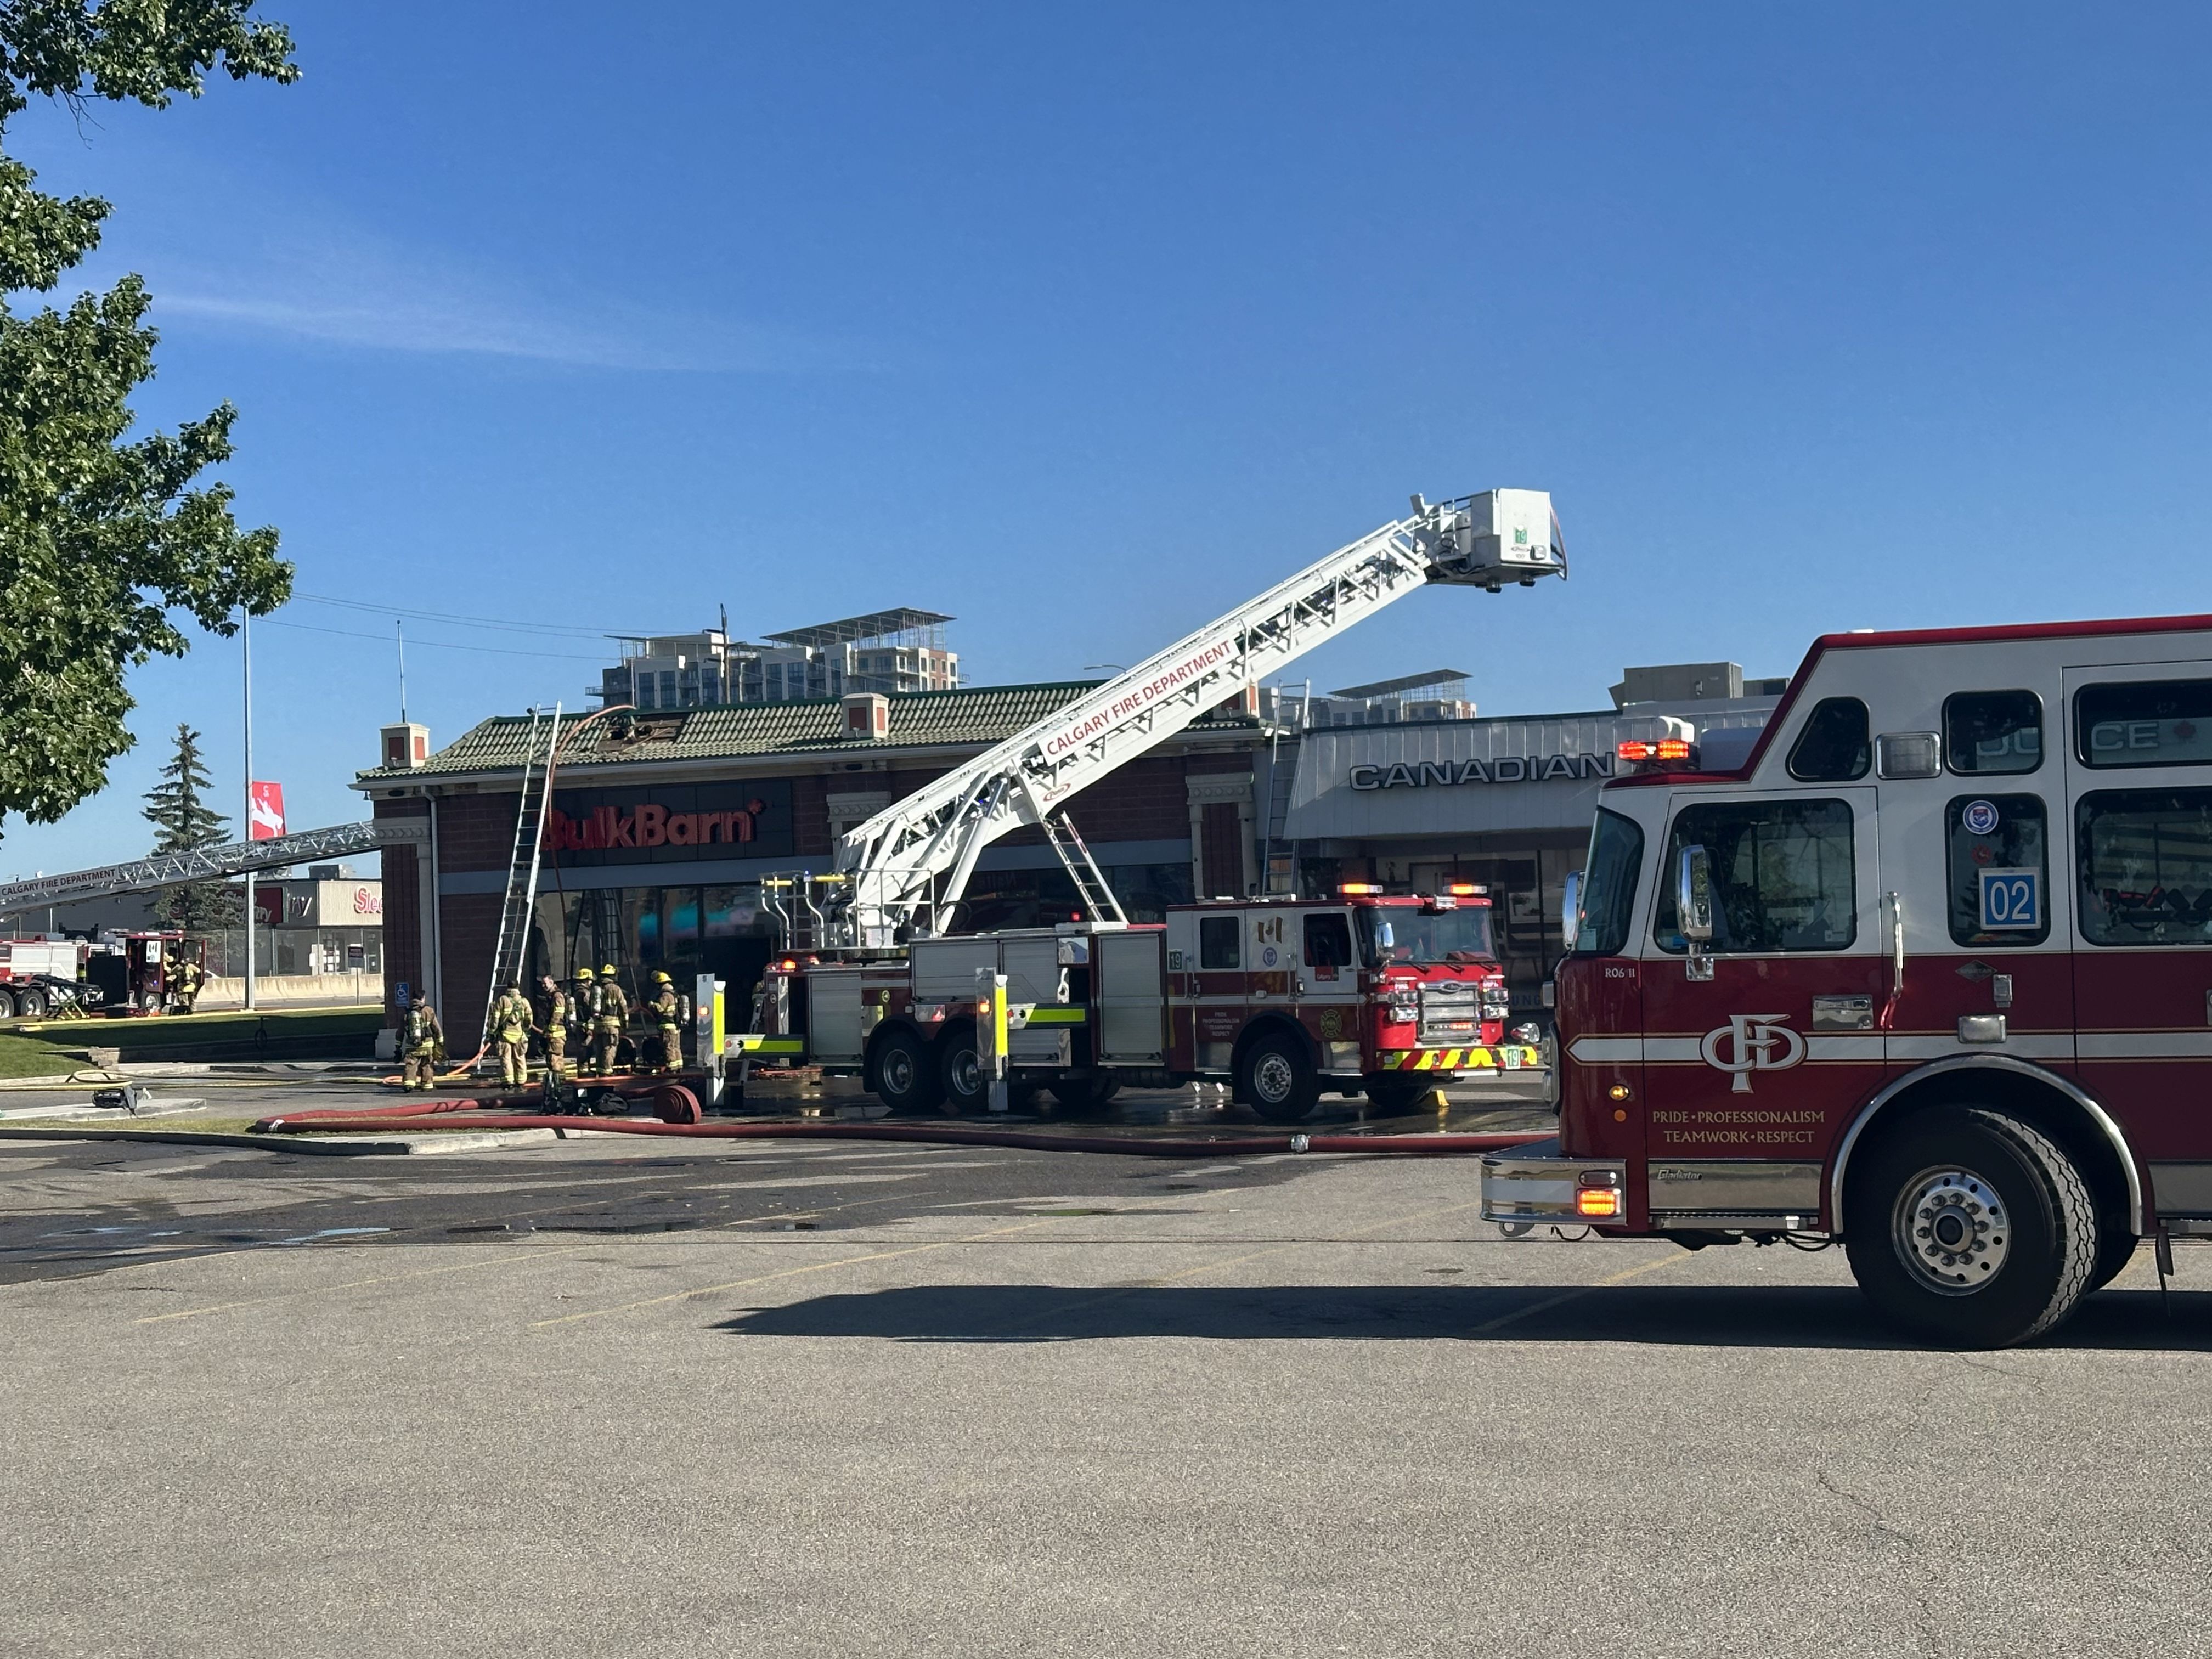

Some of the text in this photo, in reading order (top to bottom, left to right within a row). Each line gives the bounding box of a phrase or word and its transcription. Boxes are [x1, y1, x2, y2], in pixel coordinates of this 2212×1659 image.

[1516, 531, 1526, 543] 19
[1047, 640, 1231, 755] CALGARY FIRE DEPARTMENT
[1350, 752, 1614, 790] CANADIAN
[2, 868, 116, 896] CALGARY FIRE DEPARTMENT
[1989, 881, 2030, 921] 02
[1170, 953, 1180, 968] 19
[1508, 1049, 1519, 1066] 19
[1652, 1110, 1825, 1123] PRIDE PROFESSIONALISM
[1663, 1131, 1815, 1143] TEAMWORK RESPECT
[1657, 1169, 1703, 1180] Gladiator
